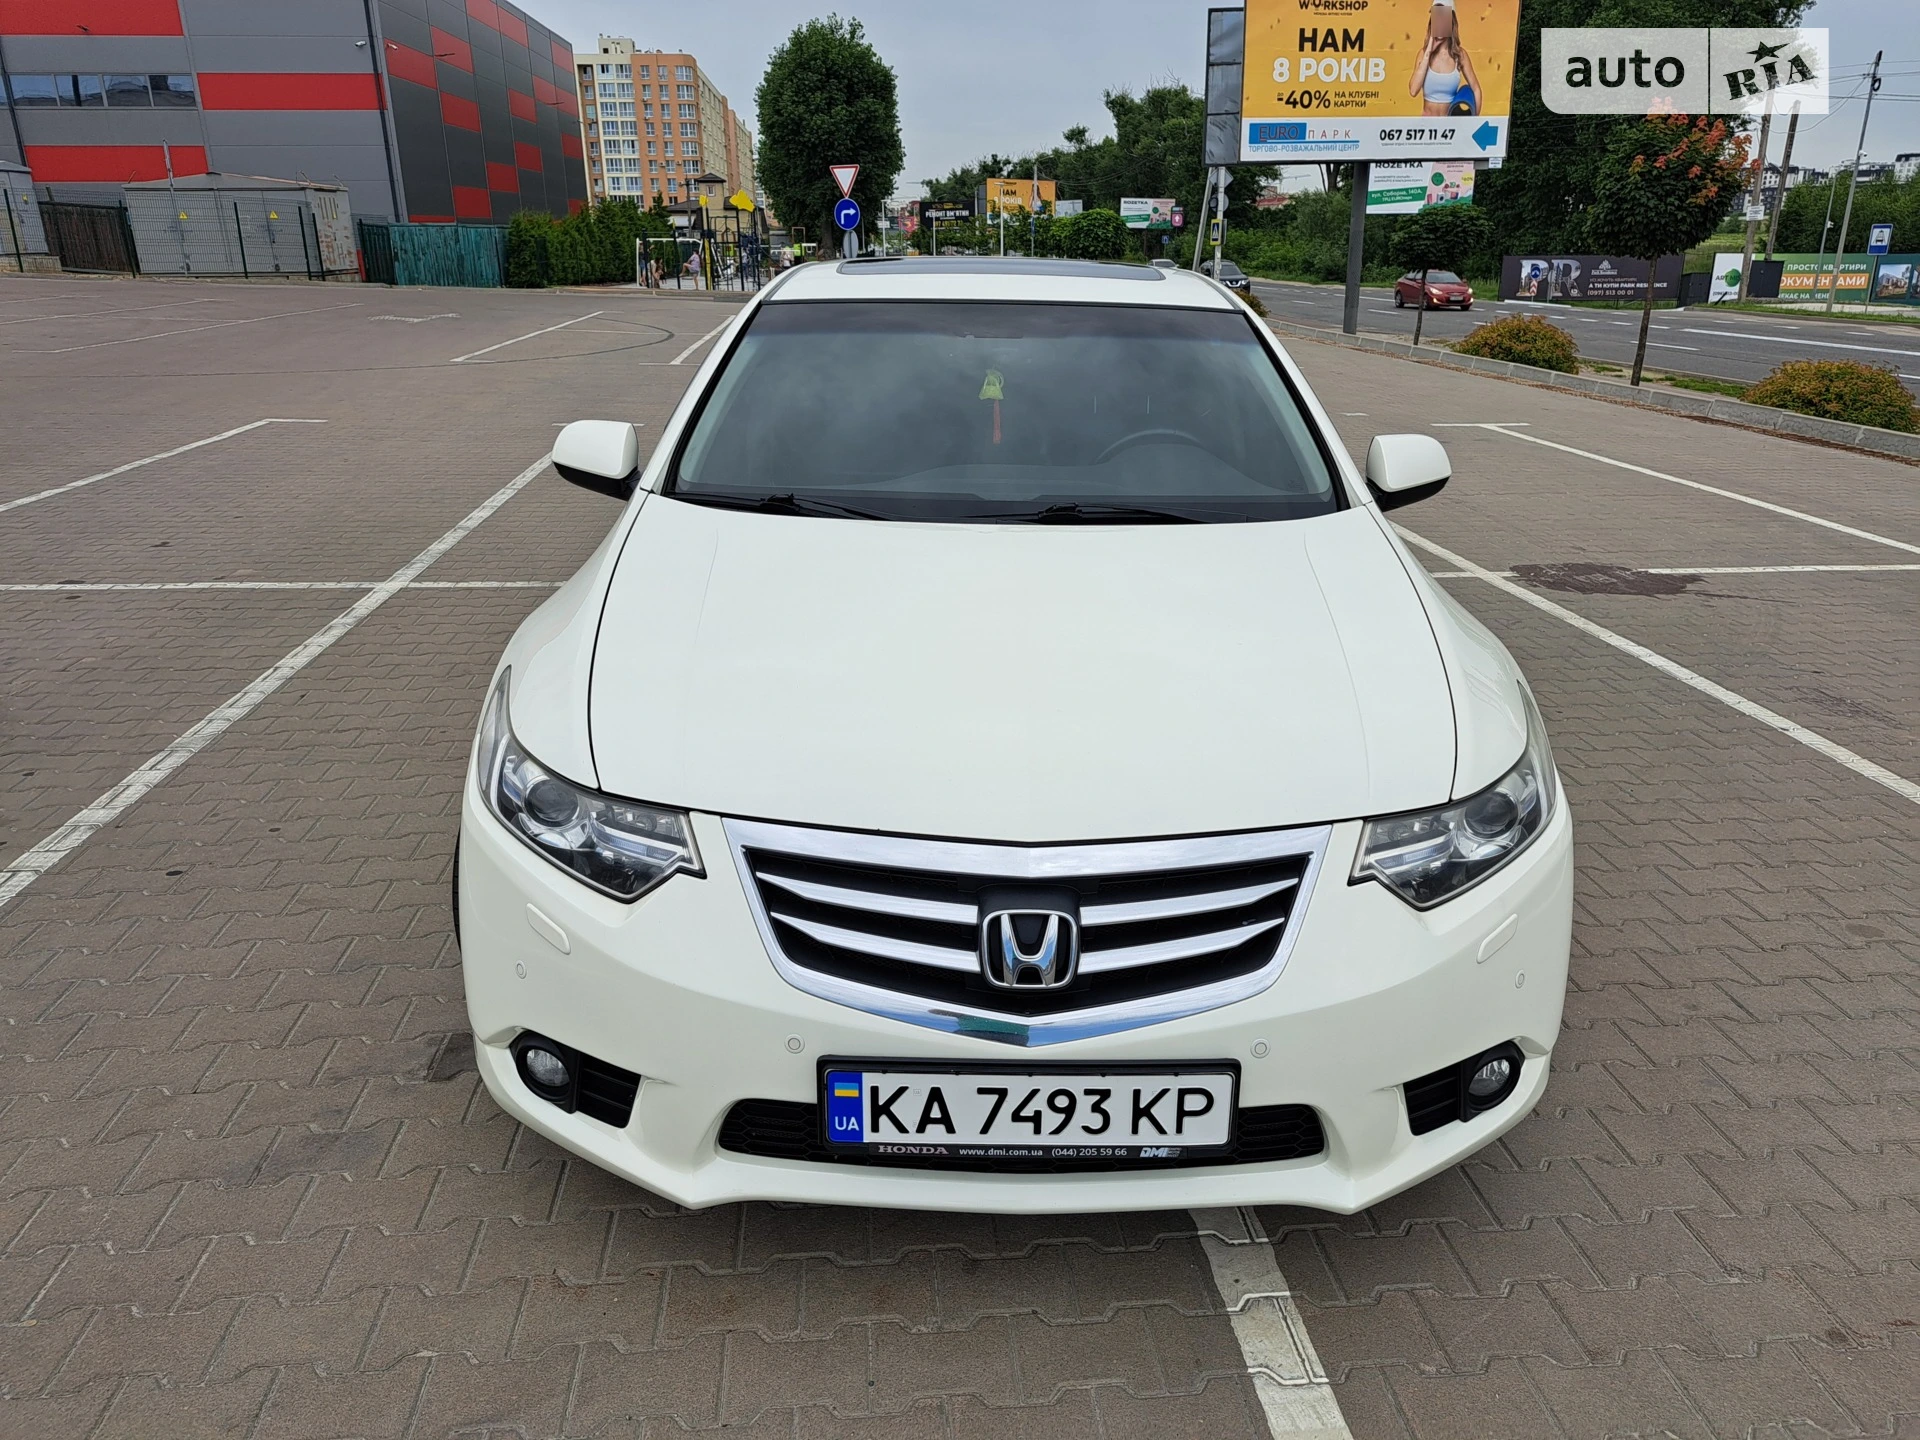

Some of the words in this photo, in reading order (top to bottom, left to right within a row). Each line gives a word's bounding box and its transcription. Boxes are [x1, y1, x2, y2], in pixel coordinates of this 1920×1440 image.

[1298, 0, 1368, 11] WORKSHOP
[1298, 28, 1365, 53] НАМ
[1272, 57, 1290, 82] 8
[1298, 57, 1386, 82] РОКІВ
[1277, 90, 1331, 109] -40%
[1348, 91, 1379, 99] КЛУБНІ
[1259, 126, 1299, 140] EURO
[1379, 129, 1402, 140] 067
[1405, 129, 1425, 140] 517
[1428, 129, 1437, 140] 11
[1440, 129, 1456, 140] 47
[1249, 144, 1338, 152] ТОРГОВО-РОЗВАЖАЛЬНИЙ
[1338, 143, 1360, 152] ЦЕНТР
[1375, 161, 1423, 169] ROZETKA
[1822, 263, 1867, 271] КВРТИРИ
[870, 1085, 957, 1134] KA
[977, 1088, 1111, 1136] 7493
[1130, 1087, 1215, 1136] KP
[834, 1116, 859, 1131] UA
[878, 1145, 949, 1155] HONDA
[959, 1147, 1043, 1156] www.dmi.com.ua
[1051, 1148, 1077, 1157] (044)
[1079, 1148, 1098, 1156] 205
[1100, 1148, 1112, 1156] 59
[1114, 1148, 1128, 1156] 66
